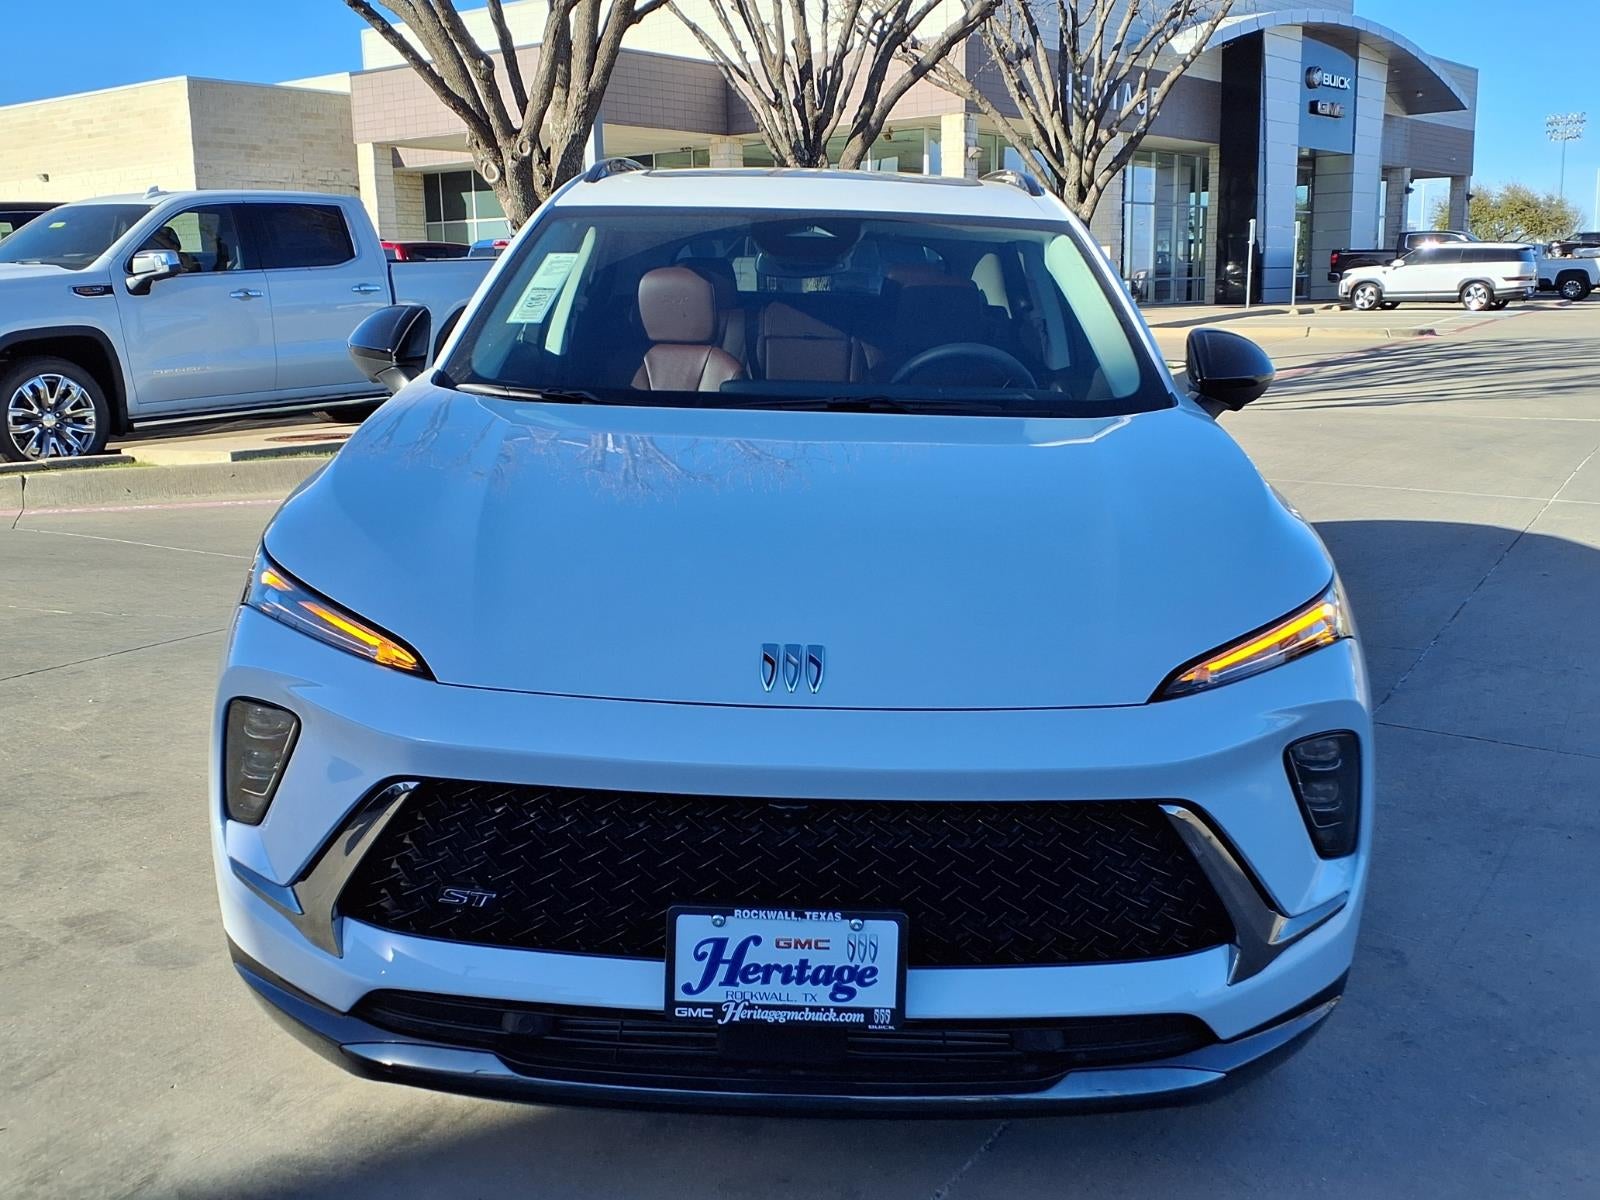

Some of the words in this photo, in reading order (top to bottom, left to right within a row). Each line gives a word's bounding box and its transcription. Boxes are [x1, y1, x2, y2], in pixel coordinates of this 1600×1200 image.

[1323, 73, 1351, 90] BUICK
[1317, 101, 1345, 117] GMC
[438, 888, 496, 907] ST
[734, 909, 801, 921] ROCKWALL,
[805, 911, 842, 922] TEXAS
[775, 937, 831, 951] GMC
[681, 935, 879, 1003] Heritage
[803, 993, 818, 1003] TX
[675, 1007, 714, 1018] GMC
[717, 1000, 865, 1025] Heritagegmcbuick.com
